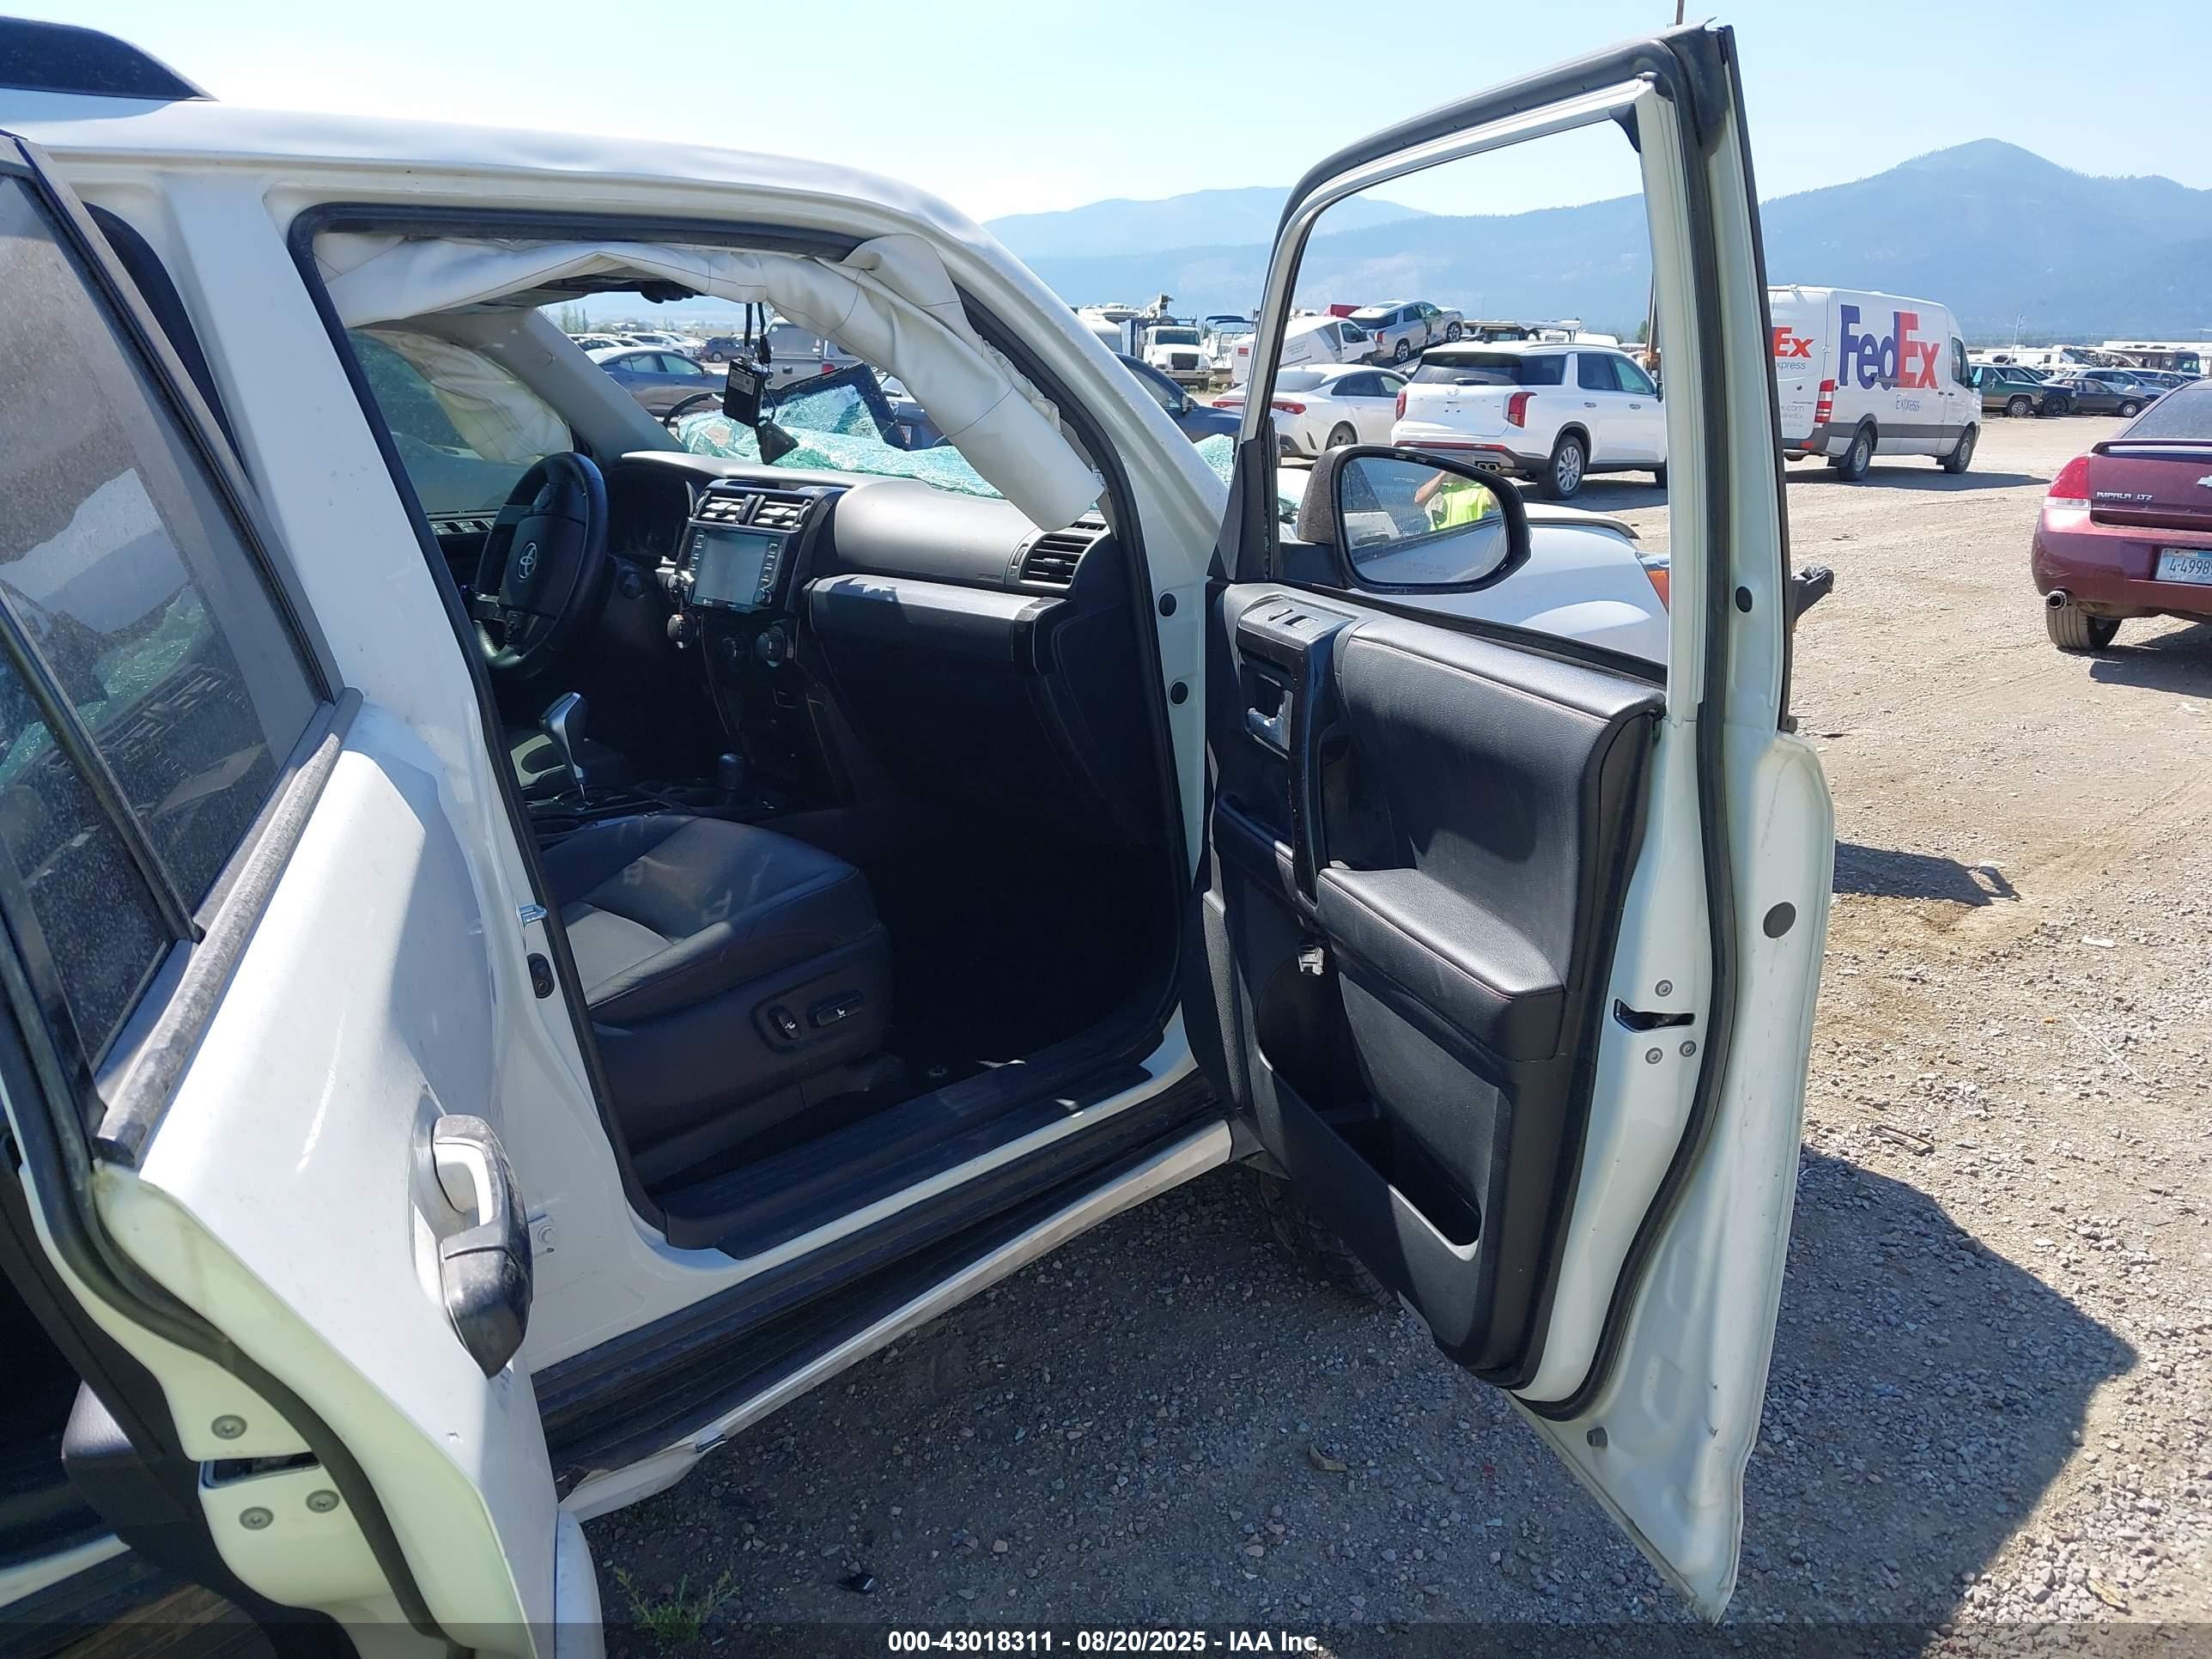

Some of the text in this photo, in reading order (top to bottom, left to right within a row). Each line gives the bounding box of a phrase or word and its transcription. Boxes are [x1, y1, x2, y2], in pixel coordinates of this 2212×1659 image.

[1771, 326, 1814, 358] Ex
[1838, 304, 1941, 391] FedEx
[1777, 362, 1807, 370] xpress
[1896, 394, 1920, 412] Express
[2169, 558, 2212, 575] 4-4998
